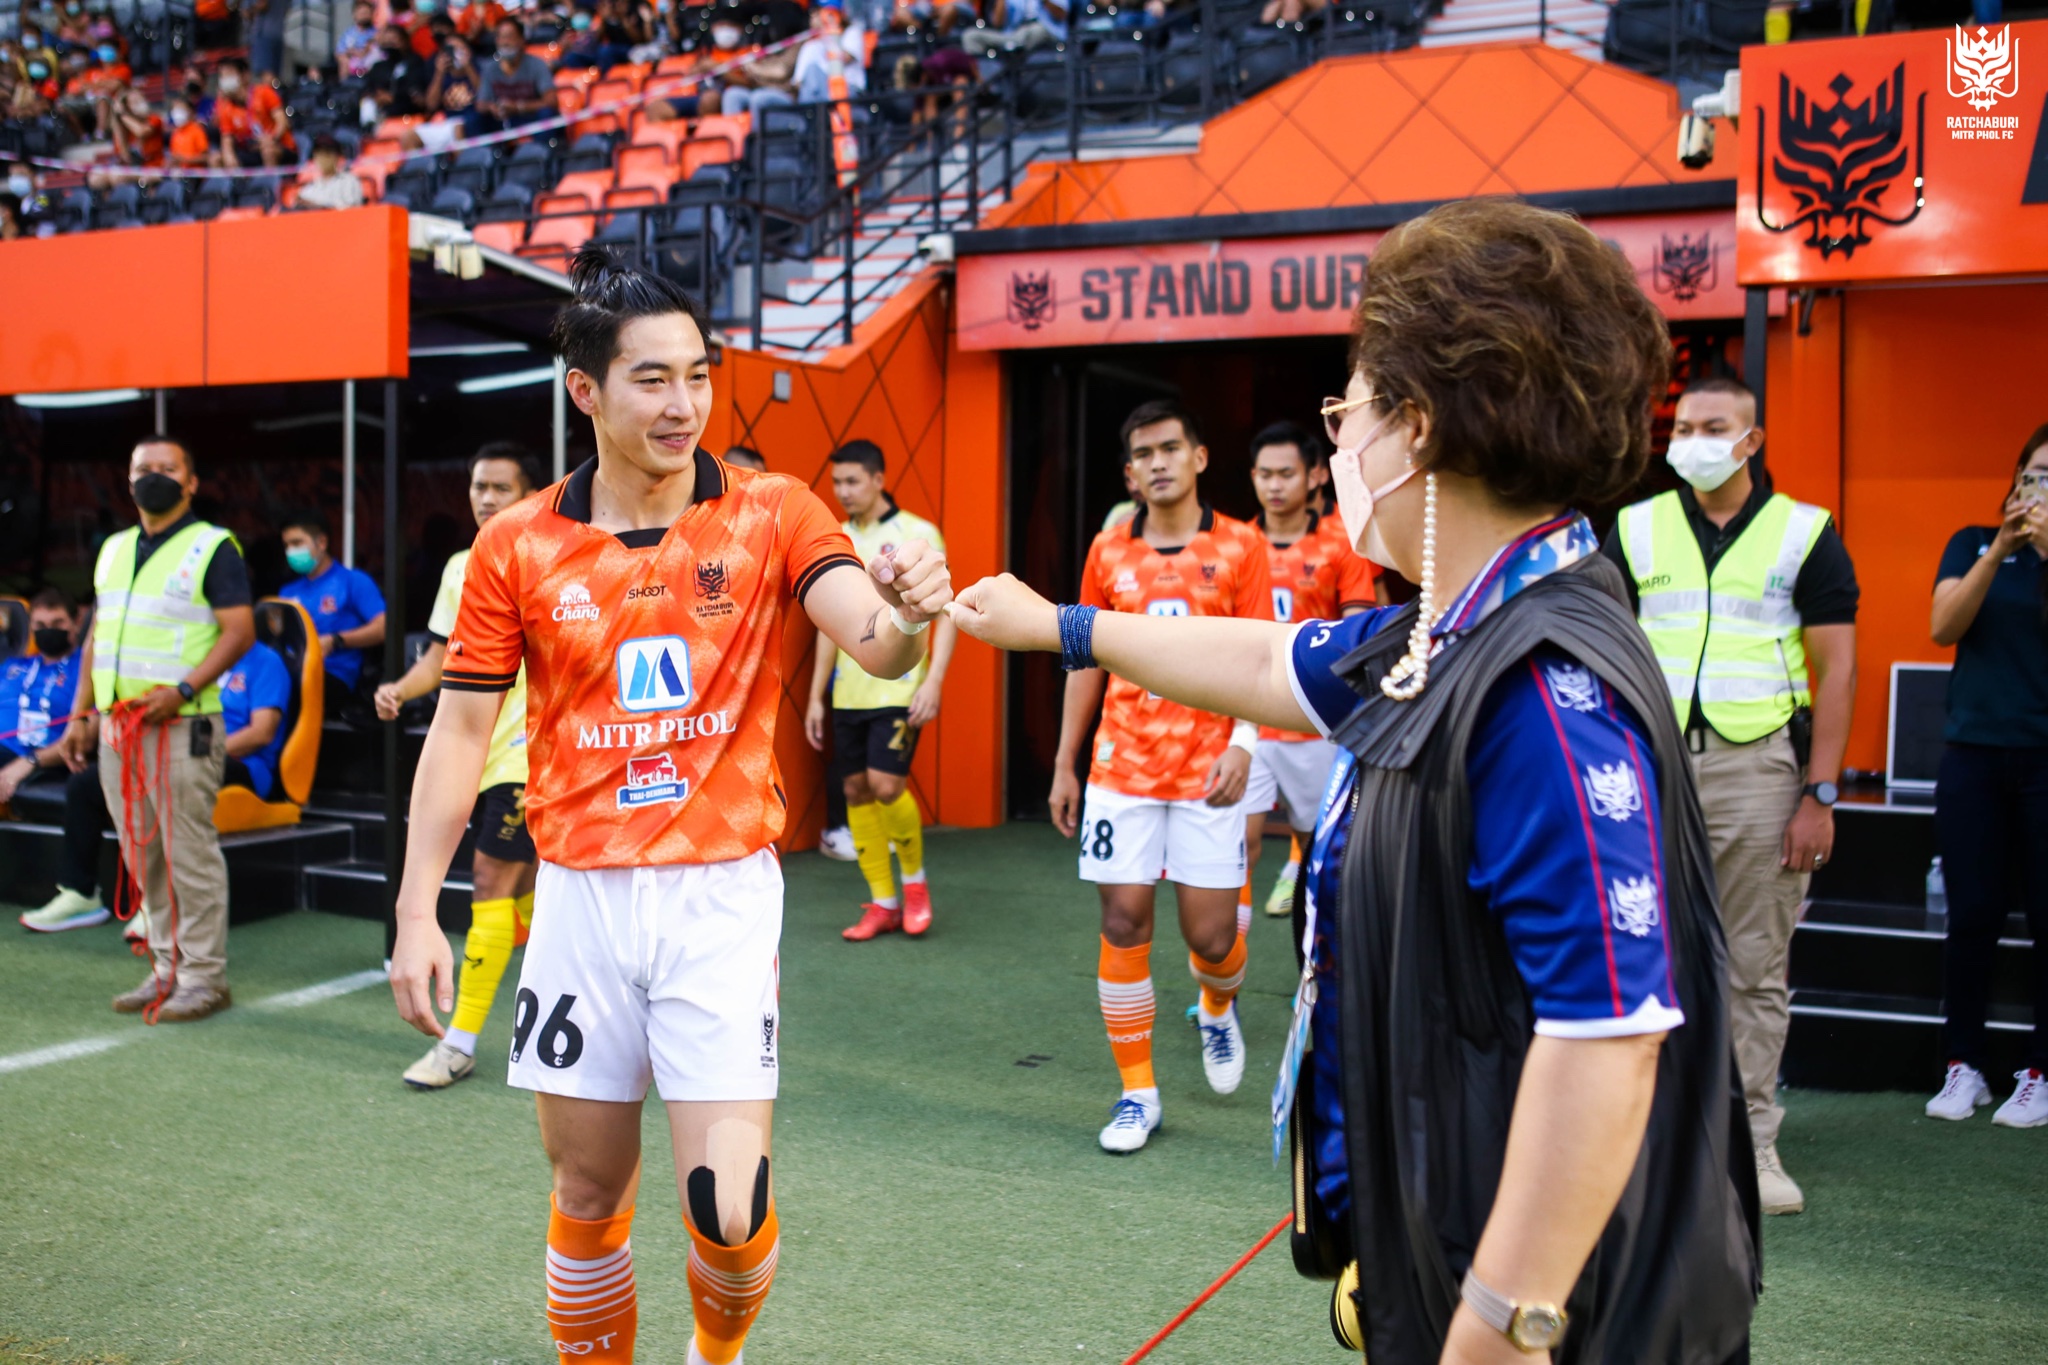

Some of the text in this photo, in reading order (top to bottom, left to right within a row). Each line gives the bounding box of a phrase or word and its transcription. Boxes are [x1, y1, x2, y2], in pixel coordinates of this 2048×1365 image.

[1080, 252, 1369, 322] STAND OUR
[628, 585, 667, 600] SHOOT
[551, 605, 601, 622] Chang
[576, 710, 737, 749] MITR PHOL
[629, 785, 676, 801] THAI-DENMARK
[510, 986, 584, 1070] 96
